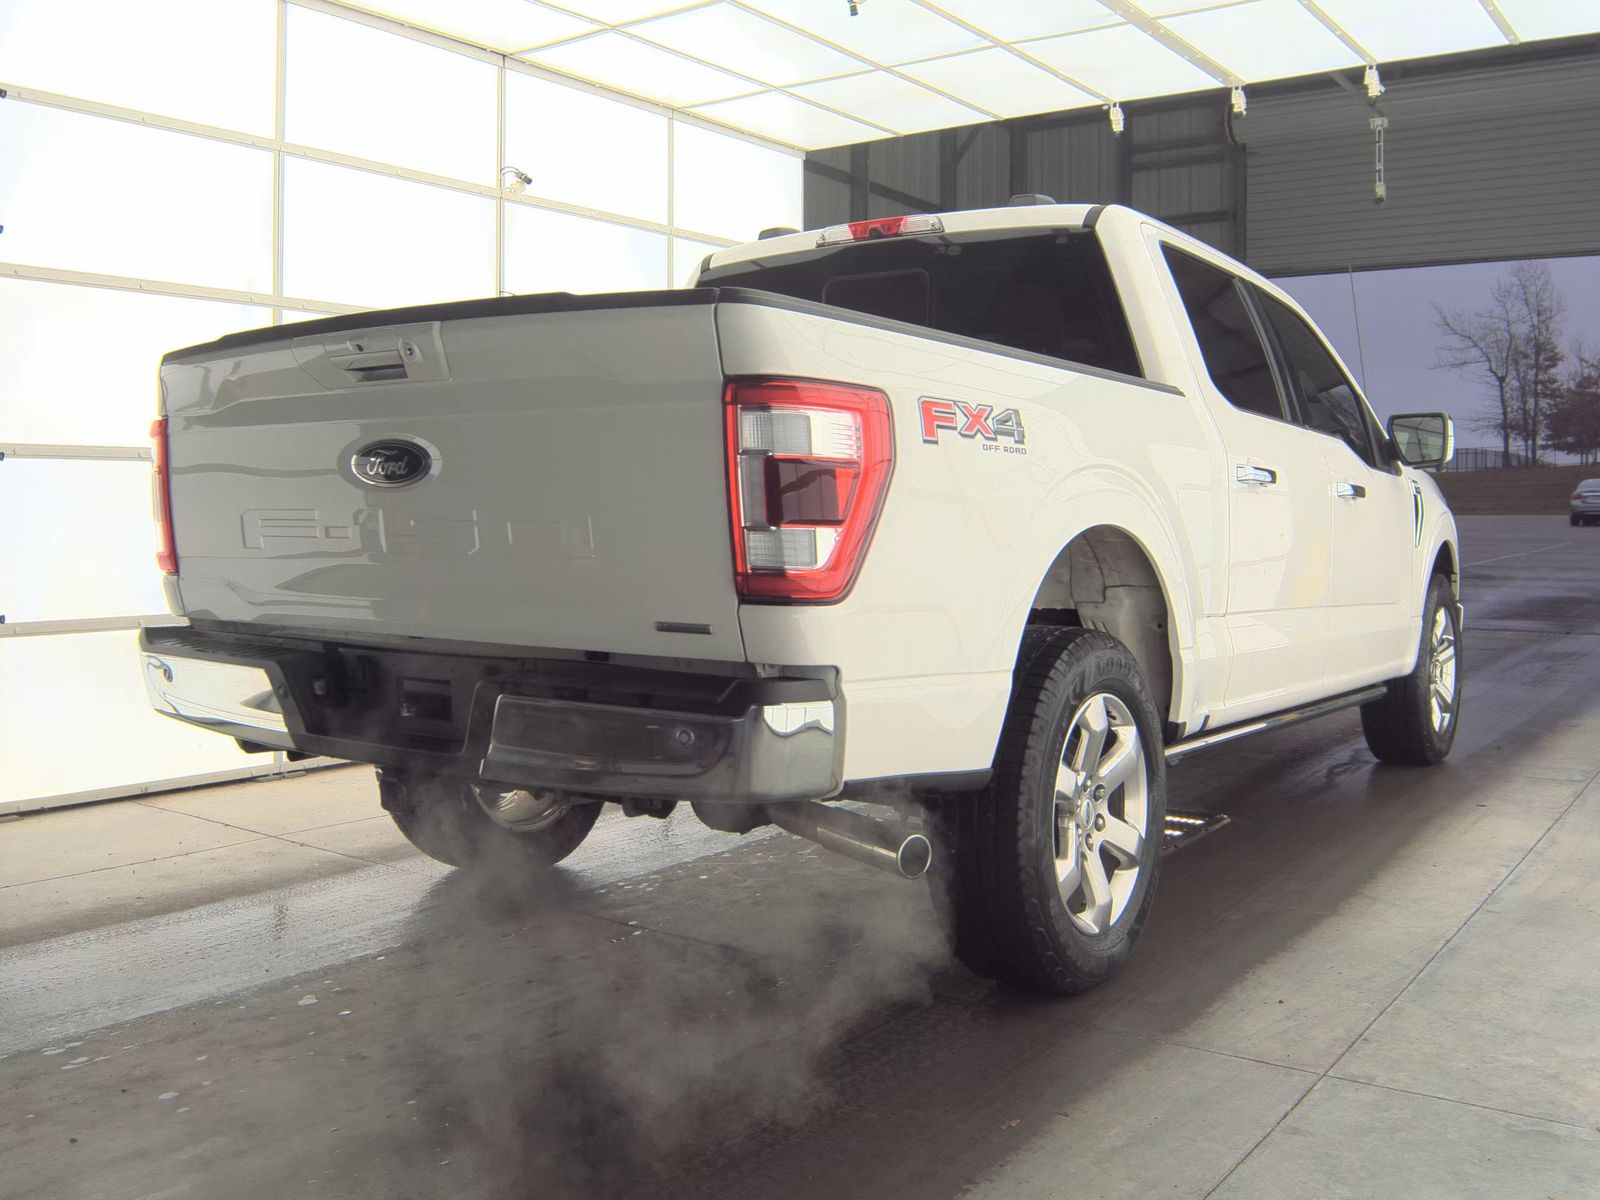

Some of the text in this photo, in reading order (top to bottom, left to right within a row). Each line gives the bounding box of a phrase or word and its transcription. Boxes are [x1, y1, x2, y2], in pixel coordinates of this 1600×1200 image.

[918, 396, 1025, 445] FX4
[366, 449, 408, 475] Ford
[982, 443, 1027, 455] OFF ROAD
